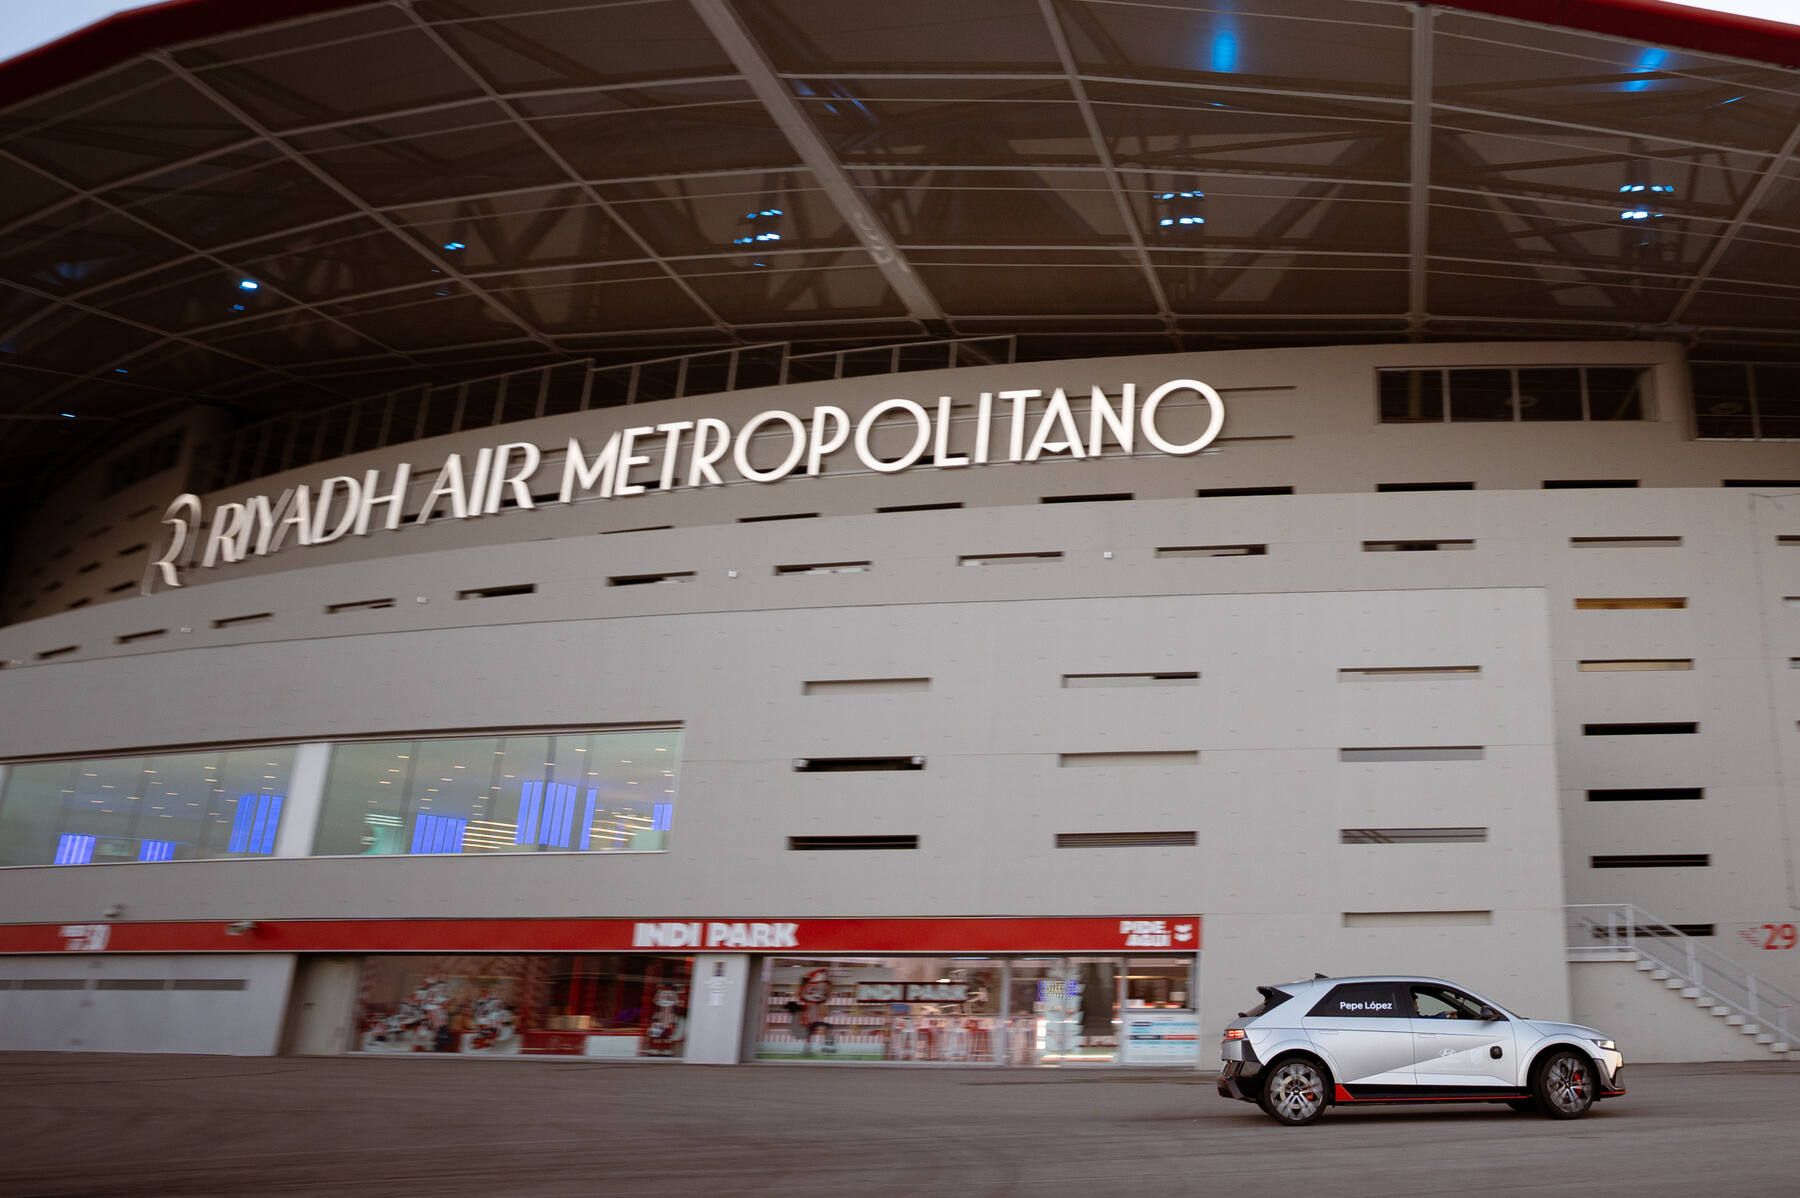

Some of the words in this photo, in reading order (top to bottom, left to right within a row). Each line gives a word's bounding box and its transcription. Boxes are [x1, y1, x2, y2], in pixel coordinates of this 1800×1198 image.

[202, 462, 411, 567] RIYADH
[415, 442, 543, 524] AIR
[559, 379, 1225, 503] METROPOLITANO
[633, 922, 703, 947] INDI
[706, 922, 799, 948] PARK
[1761, 923, 1798, 950] 29
[1340, 1001, 1363, 1011] Pepe
[1364, 1000, 1393, 1011] López
